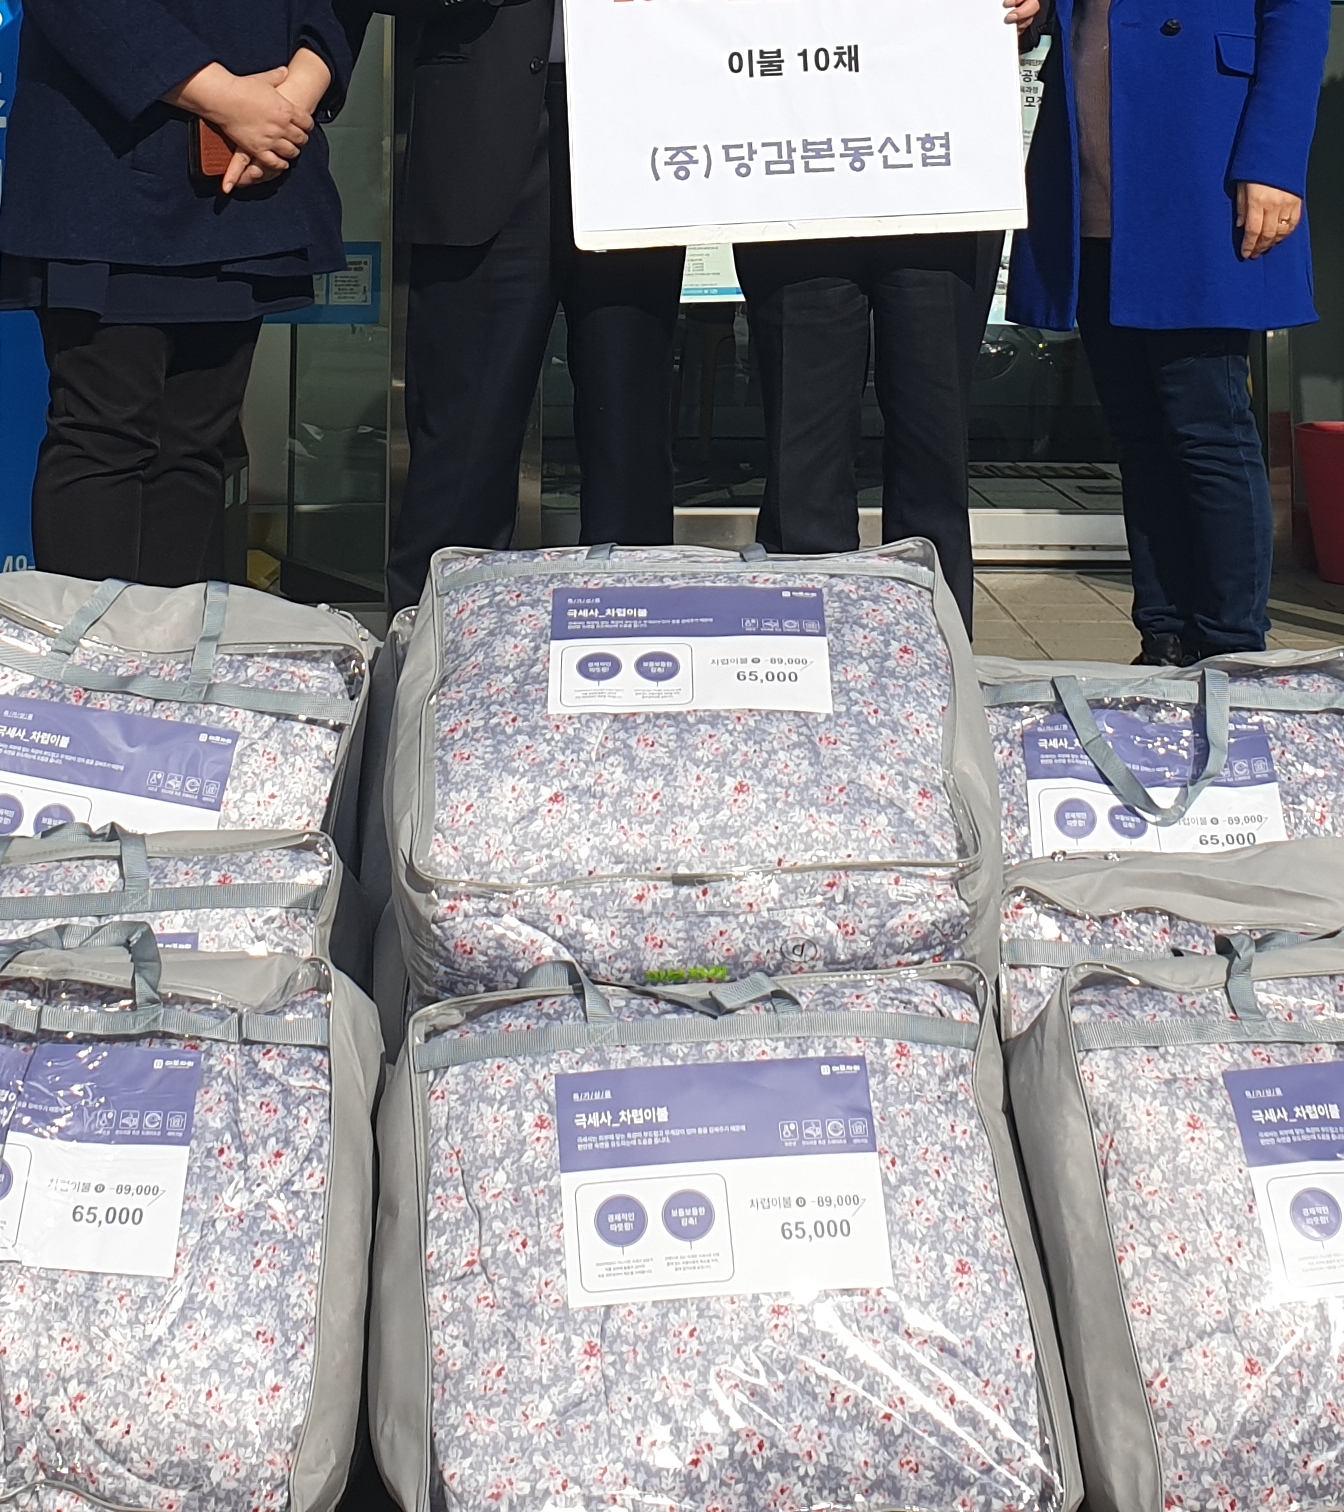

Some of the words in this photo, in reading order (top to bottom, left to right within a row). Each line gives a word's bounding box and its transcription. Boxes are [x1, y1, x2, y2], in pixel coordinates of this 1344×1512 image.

[728, 48, 785, 78] 이불
[797, 44, 860, 74] 10채
[722, 132, 951, 178] 당감본동신협
[567, 607, 648, 618] 극세사_차렵이불
[736, 670, 798, 684] 65,000
[1198, 832, 1256, 846] 65,000
[574, 1106, 669, 1129] 극세사_차렵이불
[1252, 1104, 1341, 1124] 극세사_차렵이불
[750, 1196, 792, 1211] 차렵이불
[816, 1194, 860, 1210] 89,000
[72, 1204, 144, 1228] 65,000
[780, 1218, 852, 1242] 65,000
